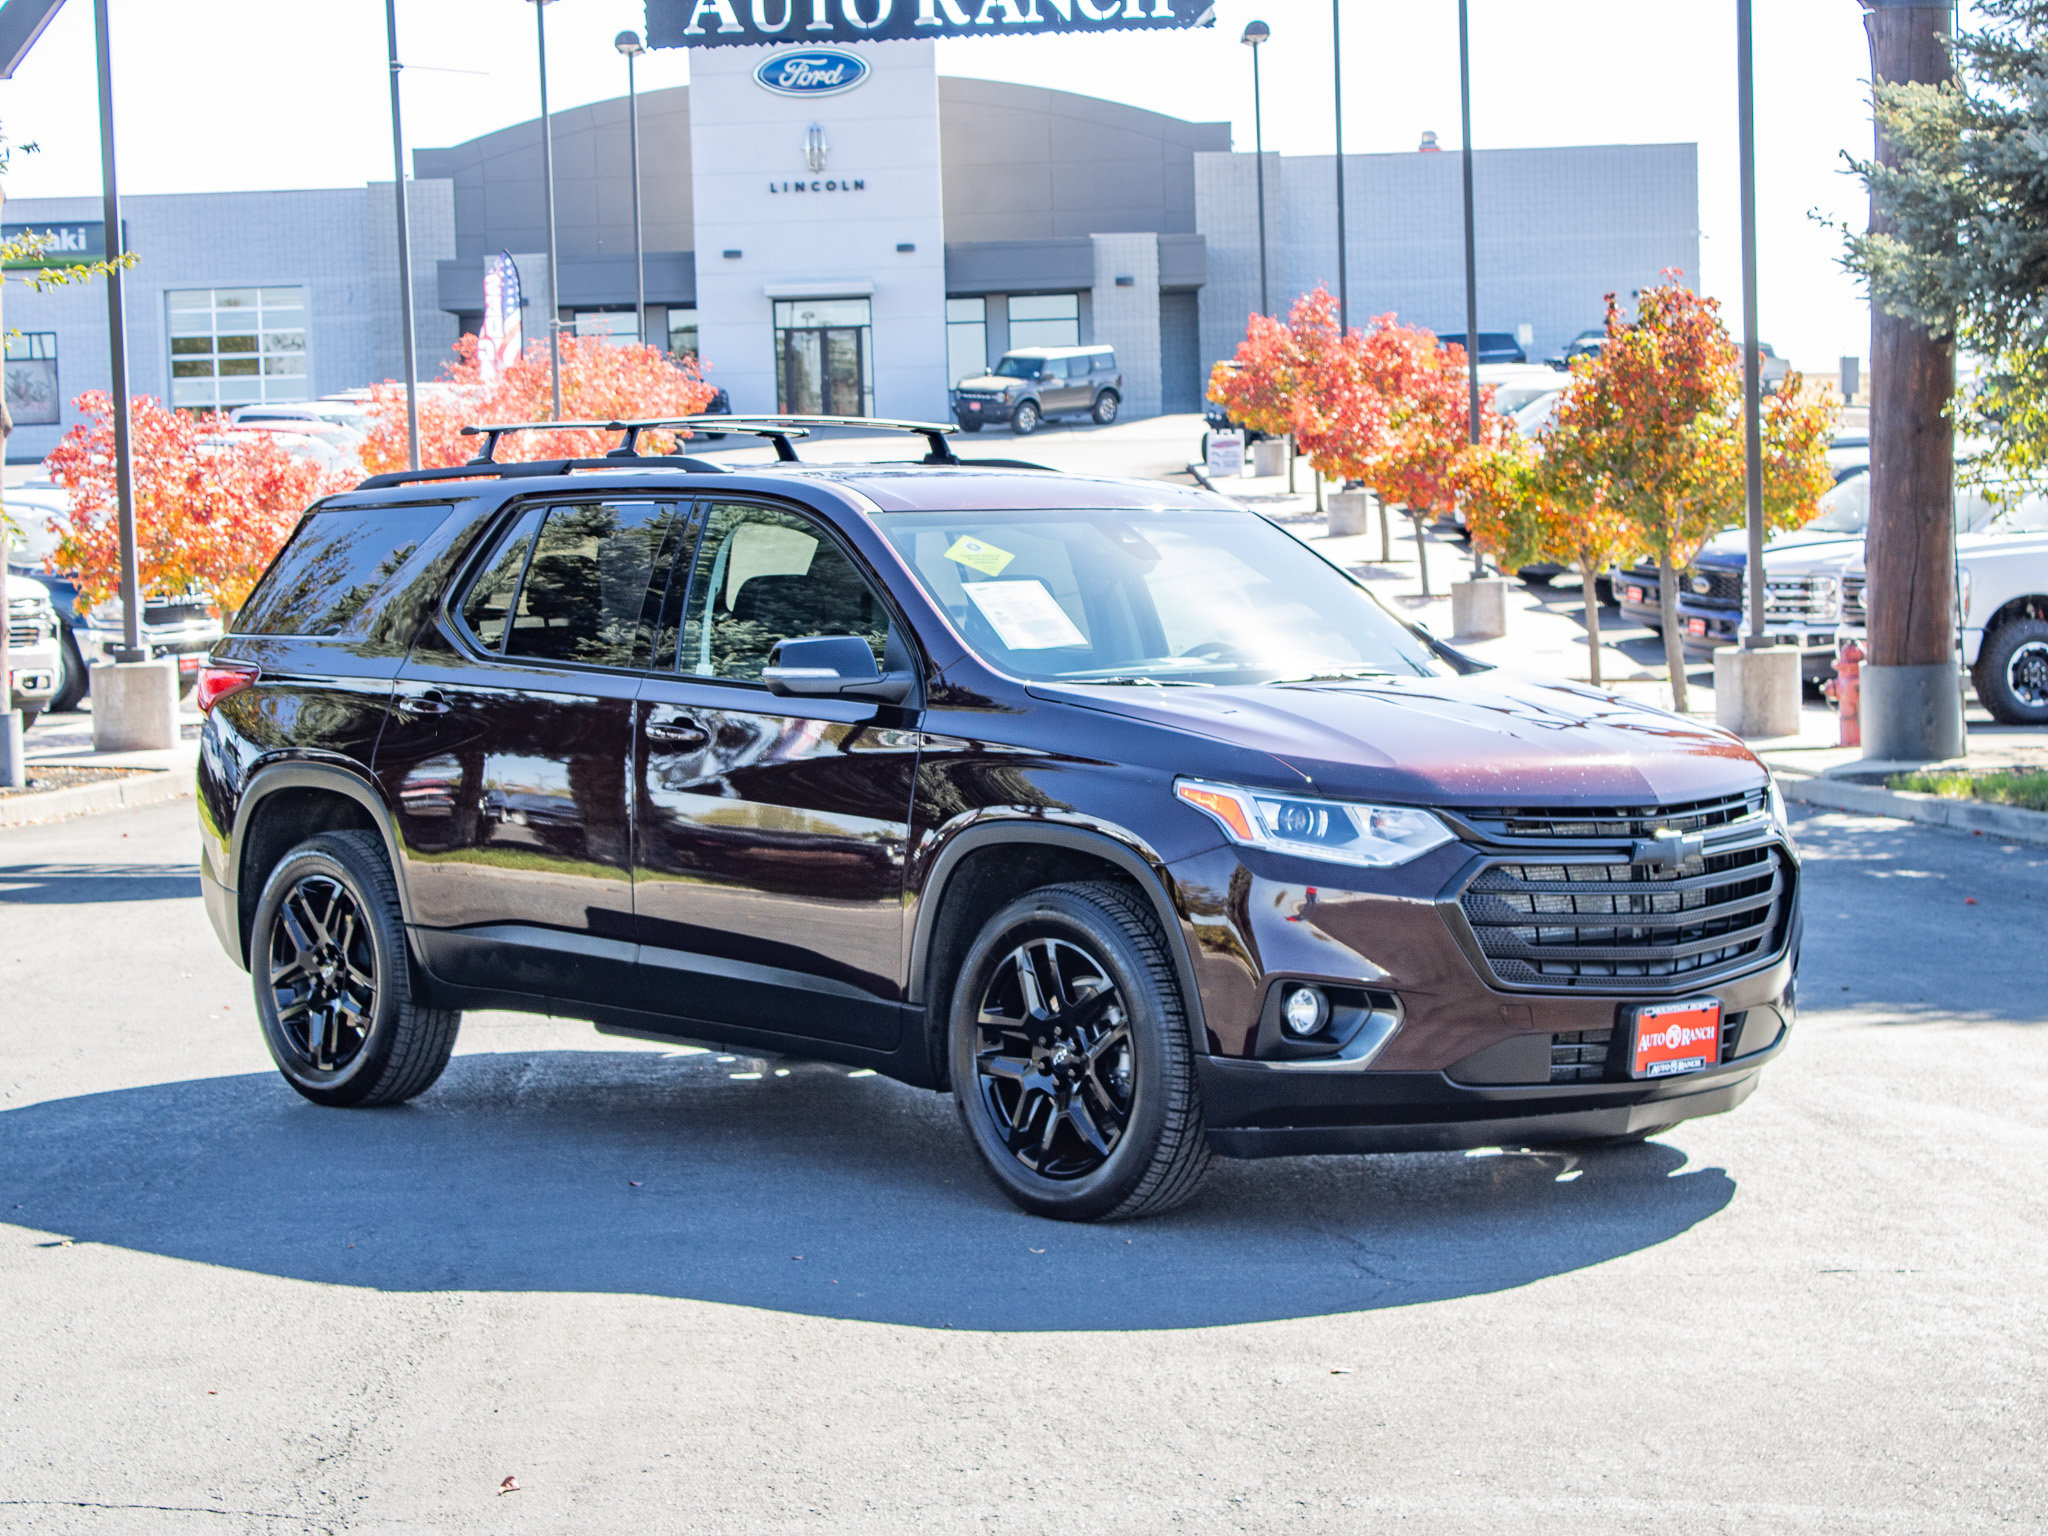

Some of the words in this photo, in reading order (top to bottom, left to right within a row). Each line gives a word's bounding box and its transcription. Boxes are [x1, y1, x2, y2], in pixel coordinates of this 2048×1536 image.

[683, 0, 893, 35] AUTO
[779, 58, 845, 87] Ford
[770, 180, 865, 193] LINCOLN
[1638, 1032, 1666, 1052] AUTO
[1680, 1026, 1715, 1046] RANCH
[1651, 1063, 1671, 1074] AUTO
[1679, 1059, 1701, 1071] RANCH
